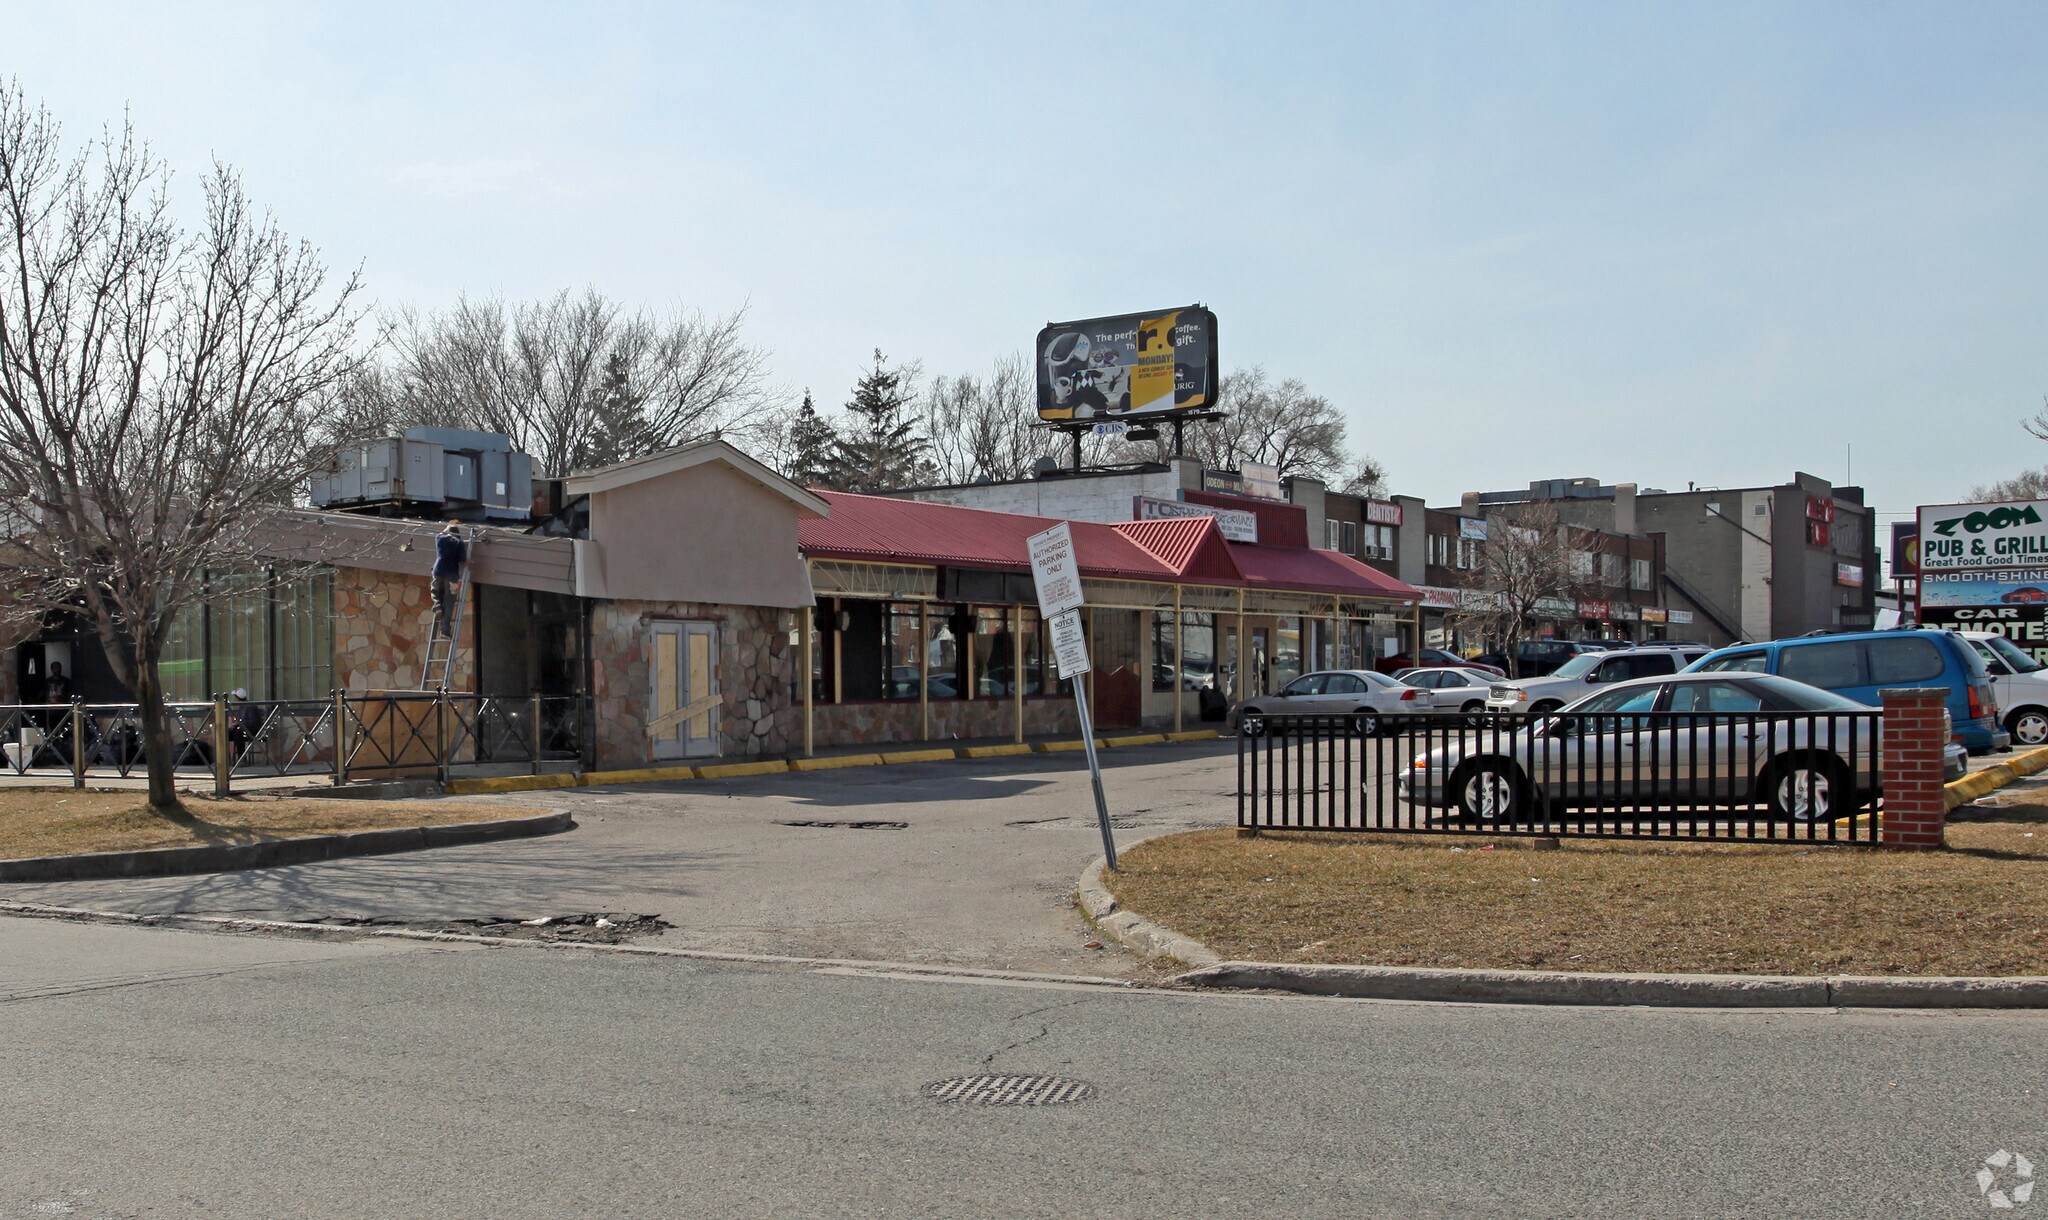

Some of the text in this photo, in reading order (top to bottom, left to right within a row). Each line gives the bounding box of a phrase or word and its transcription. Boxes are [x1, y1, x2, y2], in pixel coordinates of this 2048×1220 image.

[1095, 333, 1112, 342] The
[1176, 335, 1196, 346] gift.
[1105, 423, 1123, 433] CBS
[1206, 476, 1225, 489] ODEON
[1367, 502, 1395, 523] DENTIST
[1933, 504, 2042, 537] ZOOM
[1033, 539, 1069, 560] AUTHORIZED
[1925, 535, 2048, 557] PUB & GRILL
[1038, 550, 1067, 568] PARKING
[1925, 558, 1953, 567] Great
[1957, 557, 1982, 565] Food
[1986, 555, 2013, 565] Good
[1046, 562, 1062, 576] ONLY
[1954, 608, 2019, 619] CAR
[1055, 616, 1075, 628] NOTICE
